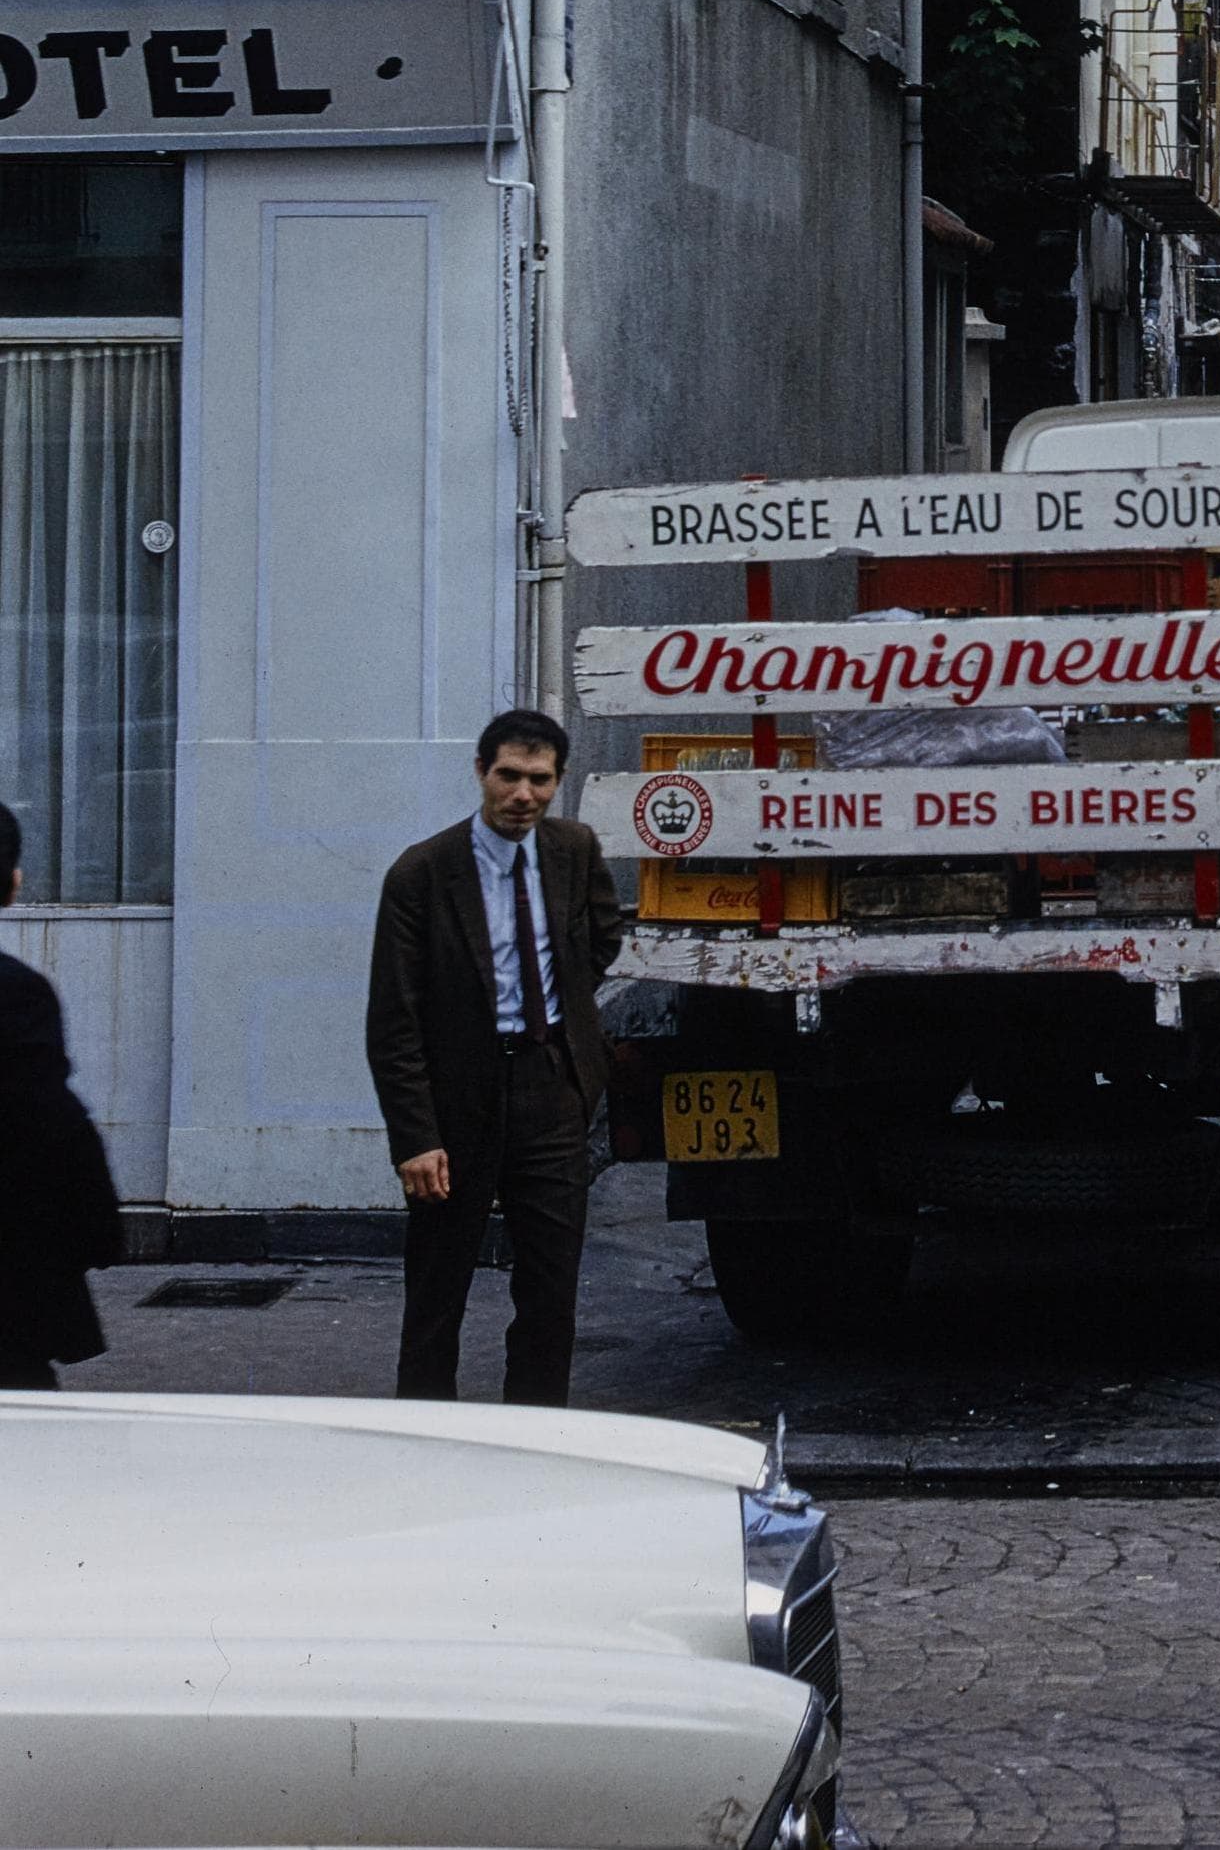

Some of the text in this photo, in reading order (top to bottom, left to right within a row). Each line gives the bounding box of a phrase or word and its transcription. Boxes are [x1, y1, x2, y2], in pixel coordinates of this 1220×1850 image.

[855, 498, 883, 538] A
[901, 493, 1002, 536] L'EAU
[1036, 490, 1084, 531] DE
[635, 775, 711, 809] CHAMPIGNEULLES
[761, 792, 883, 830] REINE
[915, 790, 998, 827] DES
[659, 843, 682, 854] DES
[674, 1077, 767, 1115] 8624
